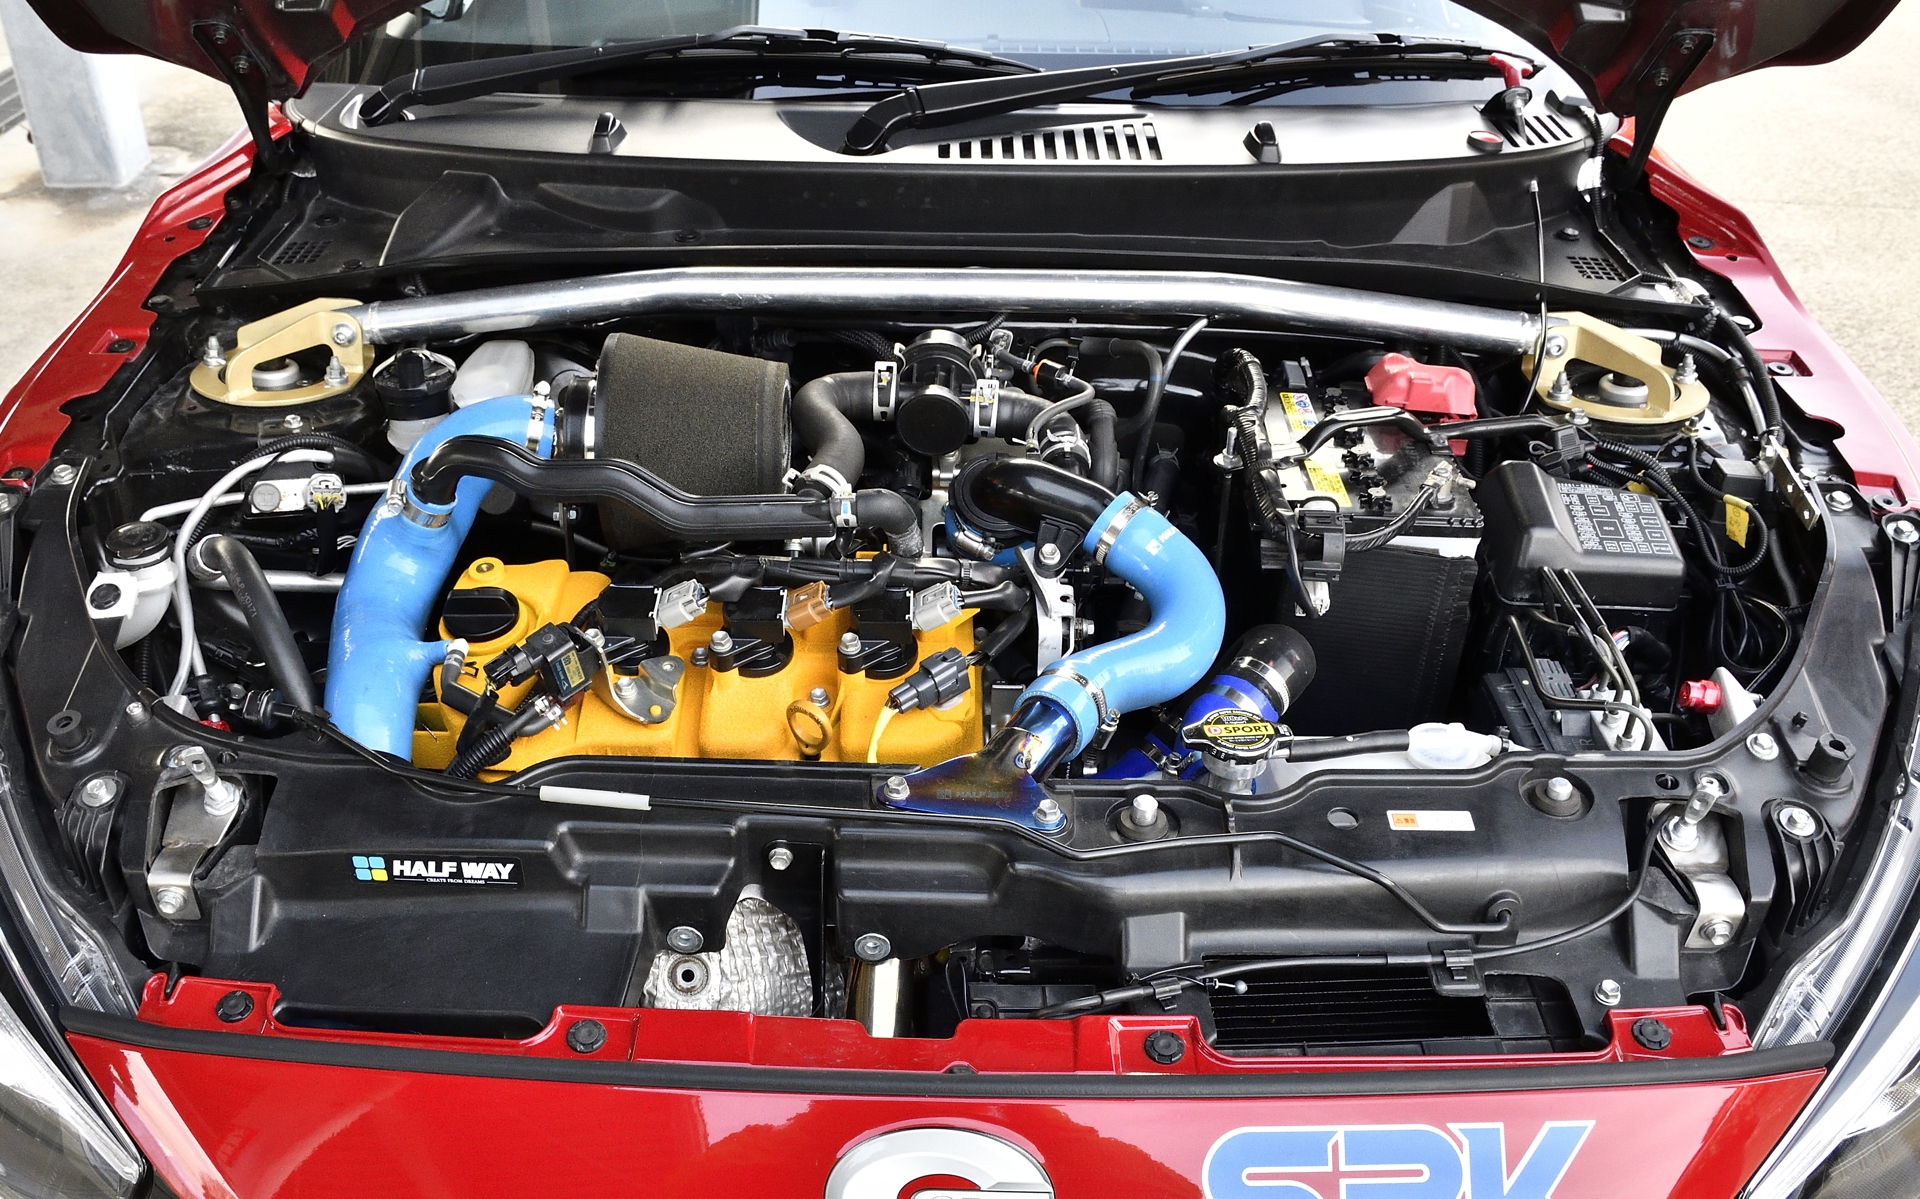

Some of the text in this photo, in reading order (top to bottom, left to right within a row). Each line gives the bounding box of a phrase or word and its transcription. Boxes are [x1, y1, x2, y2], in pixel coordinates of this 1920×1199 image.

[1223, 725, 1269, 734] SPORT
[393, 859, 514, 880] HALF WAY
